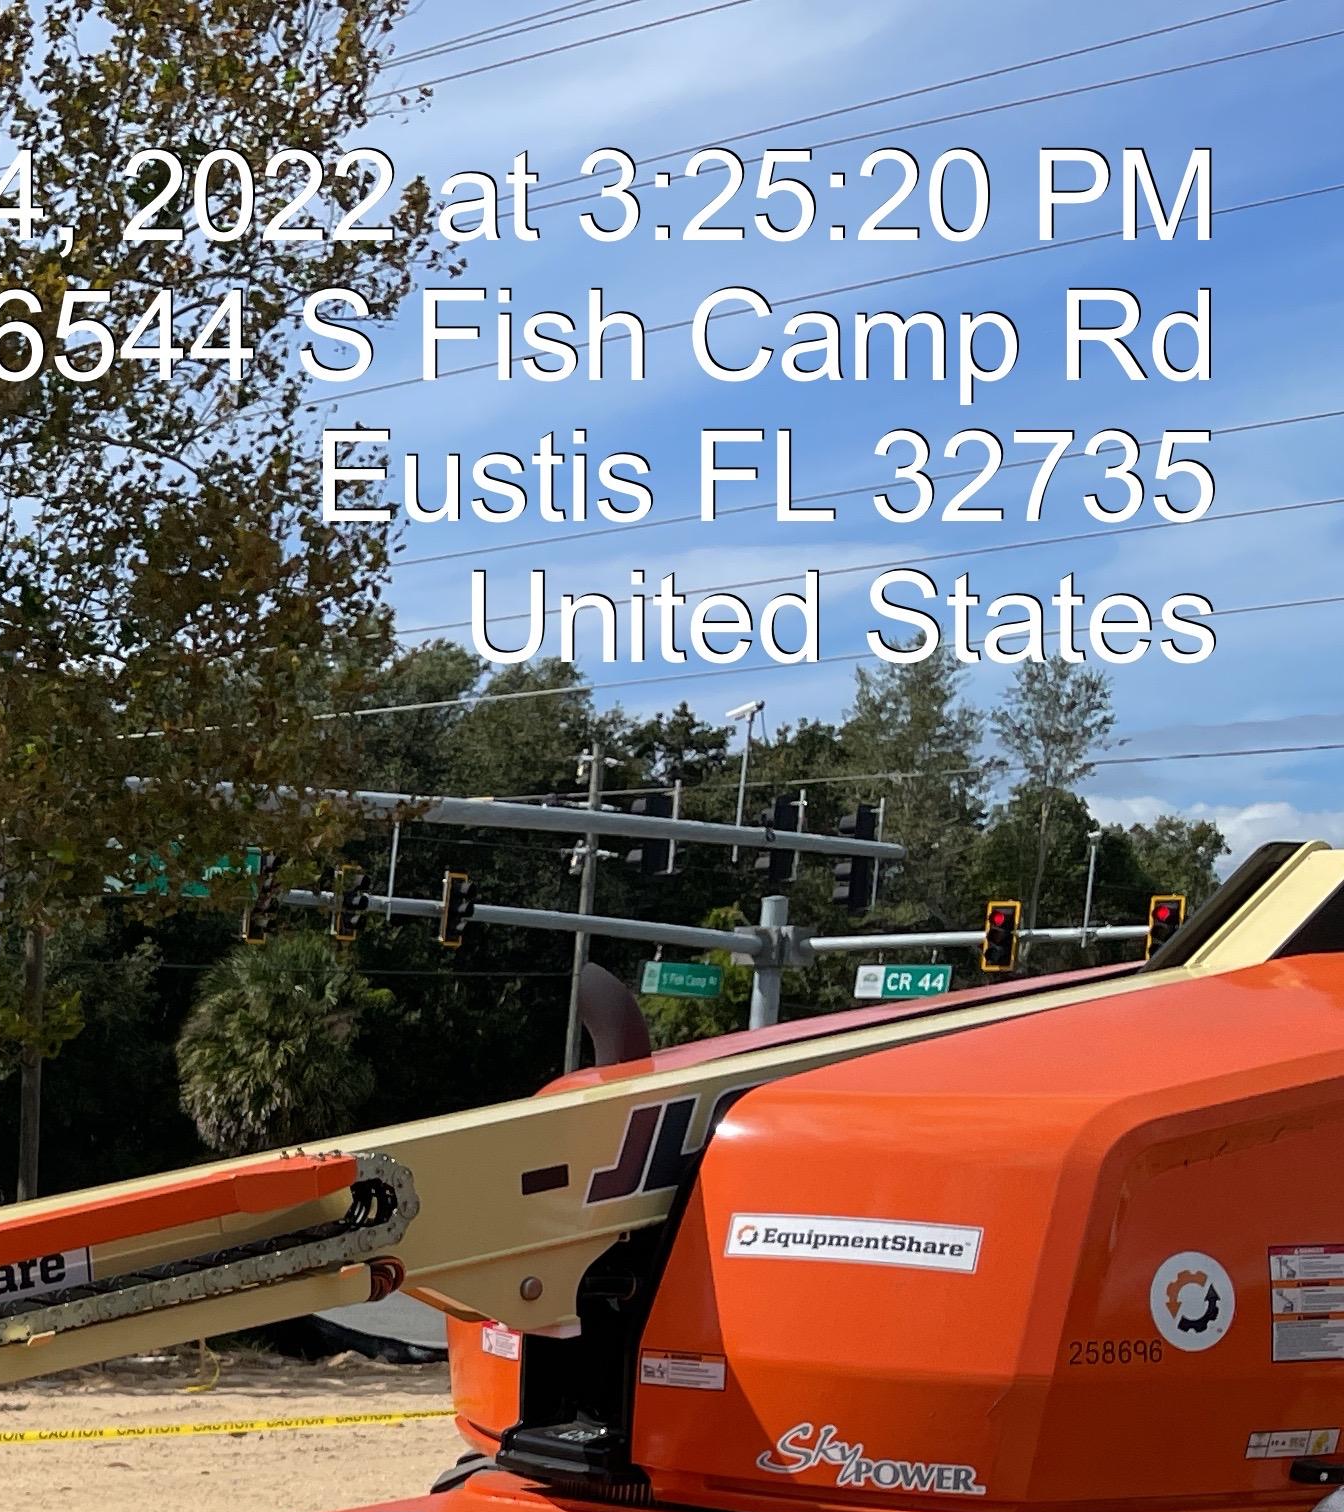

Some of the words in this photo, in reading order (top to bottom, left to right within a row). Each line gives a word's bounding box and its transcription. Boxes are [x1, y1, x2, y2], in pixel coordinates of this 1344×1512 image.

[886, 972, 913, 992] CR
[917, 972, 945, 992] 44
[583, 1084, 752, 1208] JL
[761, 1227, 965, 1258] EquipmentShare
[1068, 1339, 1162, 1366] 258696
[758, 1423, 863, 1486] Sky
[854, 1460, 979, 1492] POWER
